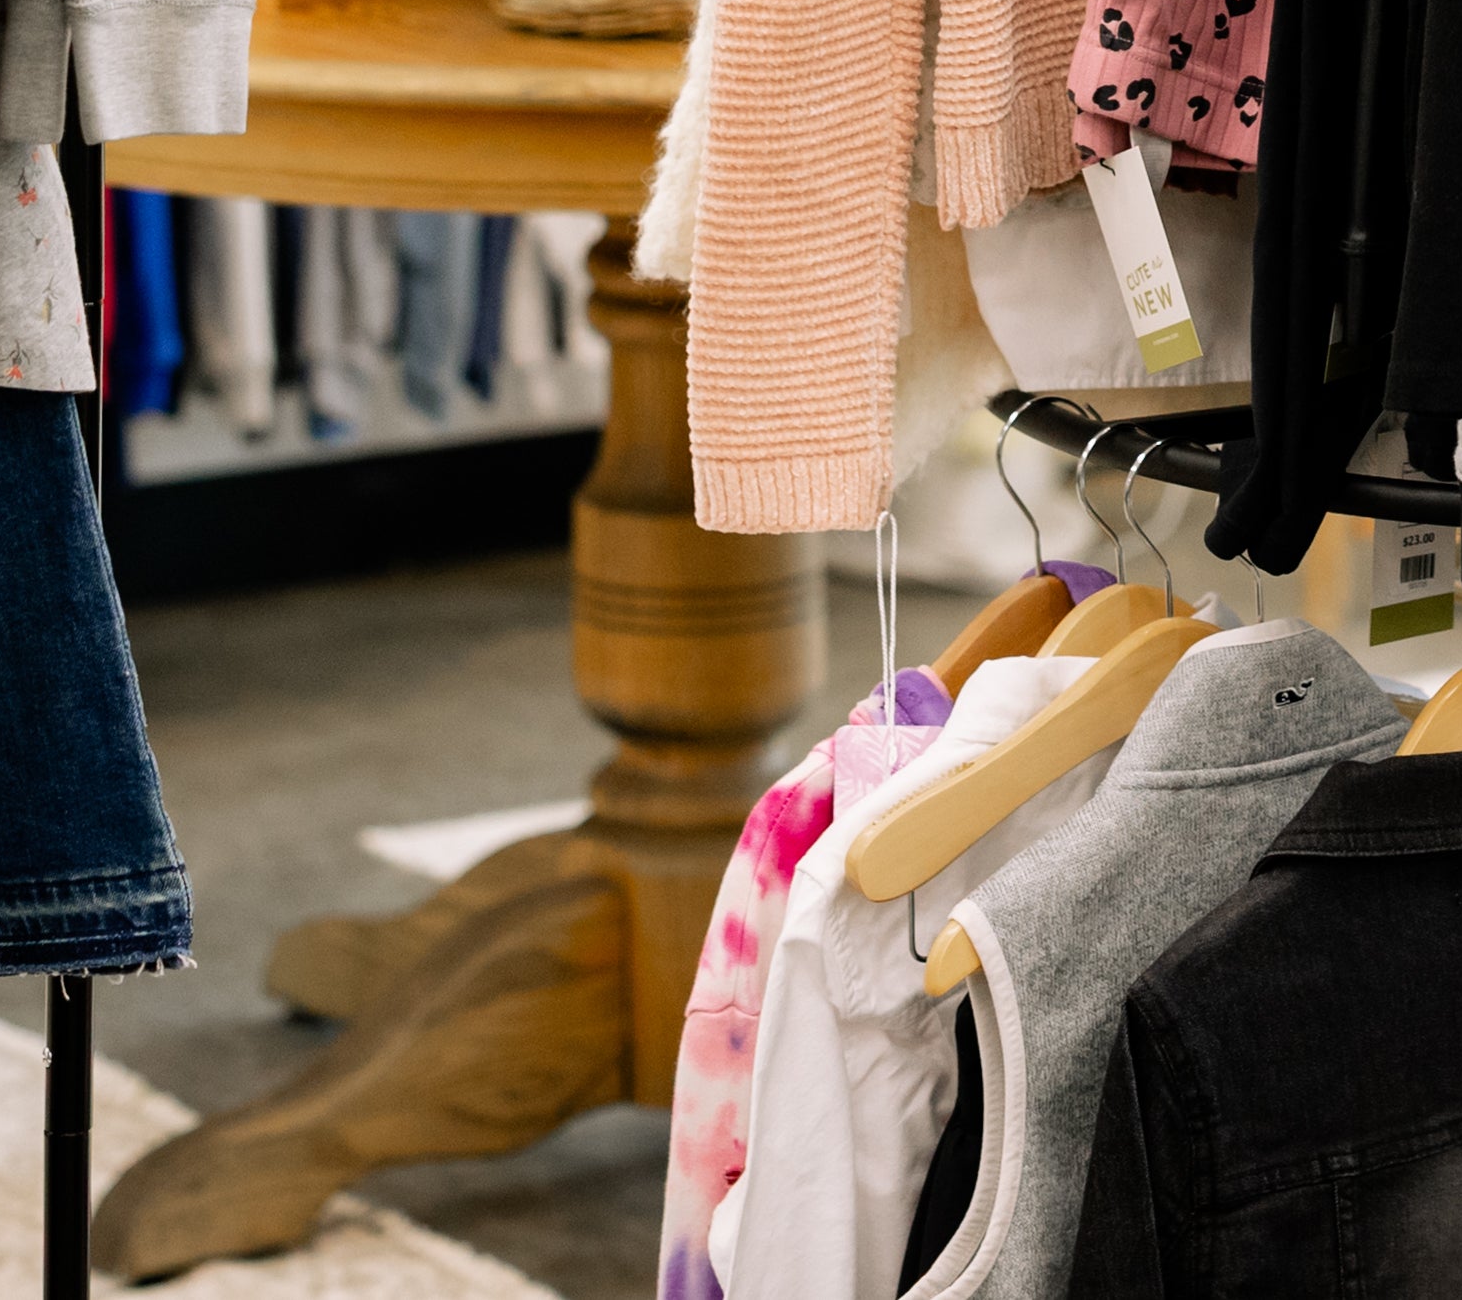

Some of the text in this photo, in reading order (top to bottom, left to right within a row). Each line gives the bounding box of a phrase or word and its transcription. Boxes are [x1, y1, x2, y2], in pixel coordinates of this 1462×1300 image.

[1126, 262, 1152, 292] CUTE
[1132, 282, 1173, 320] NEW
[1402, 532, 1436, 548] $23.00
